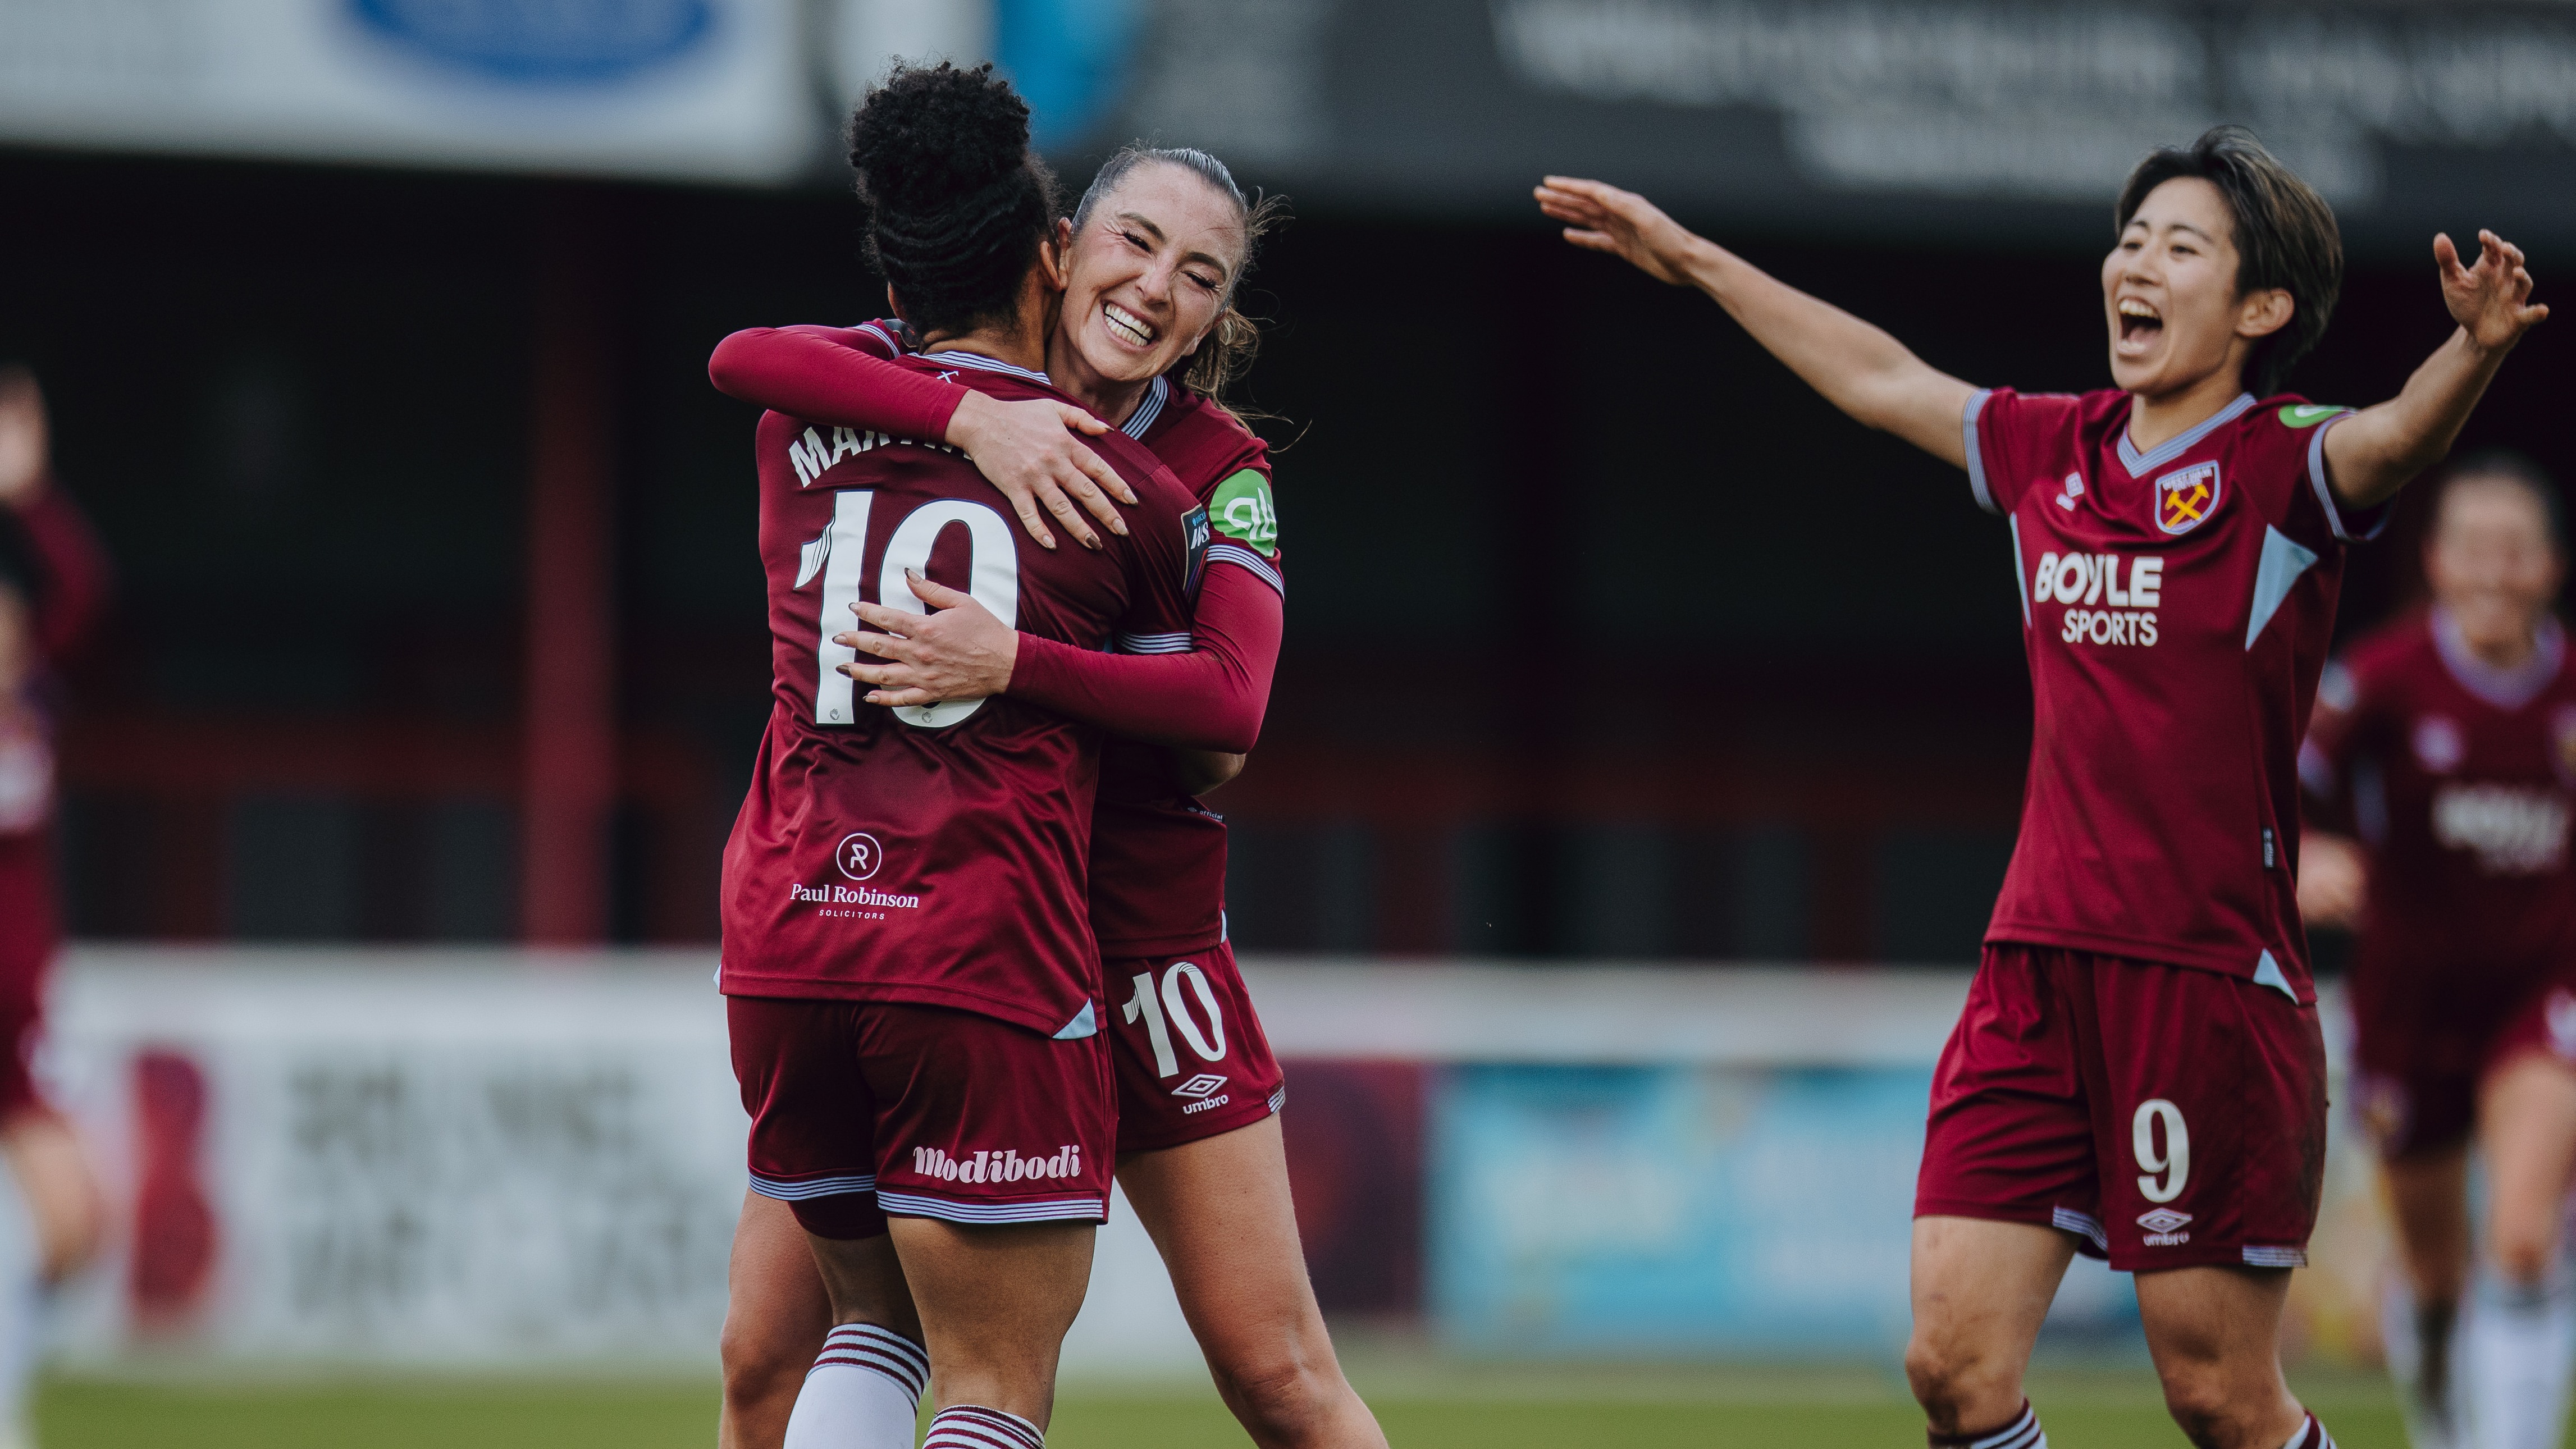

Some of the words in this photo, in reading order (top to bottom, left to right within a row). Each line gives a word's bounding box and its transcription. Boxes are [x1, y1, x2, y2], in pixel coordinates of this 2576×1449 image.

[1190, 522, 1210, 549] WS
[2034, 551, 2164, 608] BOYLE
[793, 489, 1020, 728] 10
[2061, 608, 2158, 647] SPORTS
[1199, 810, 1223, 820] official
[789, 883, 830, 902] Paul
[832, 885, 919, 908] Robinson
[819, 909, 885, 920] SOLICITORS
[1122, 962, 1227, 1078] 10
[1182, 1094, 1229, 1114] umbro
[913, 1145, 1081, 1183] Modibodi
[2132, 1098, 2190, 1204] 9
[2142, 1231, 2190, 1247] umbro
